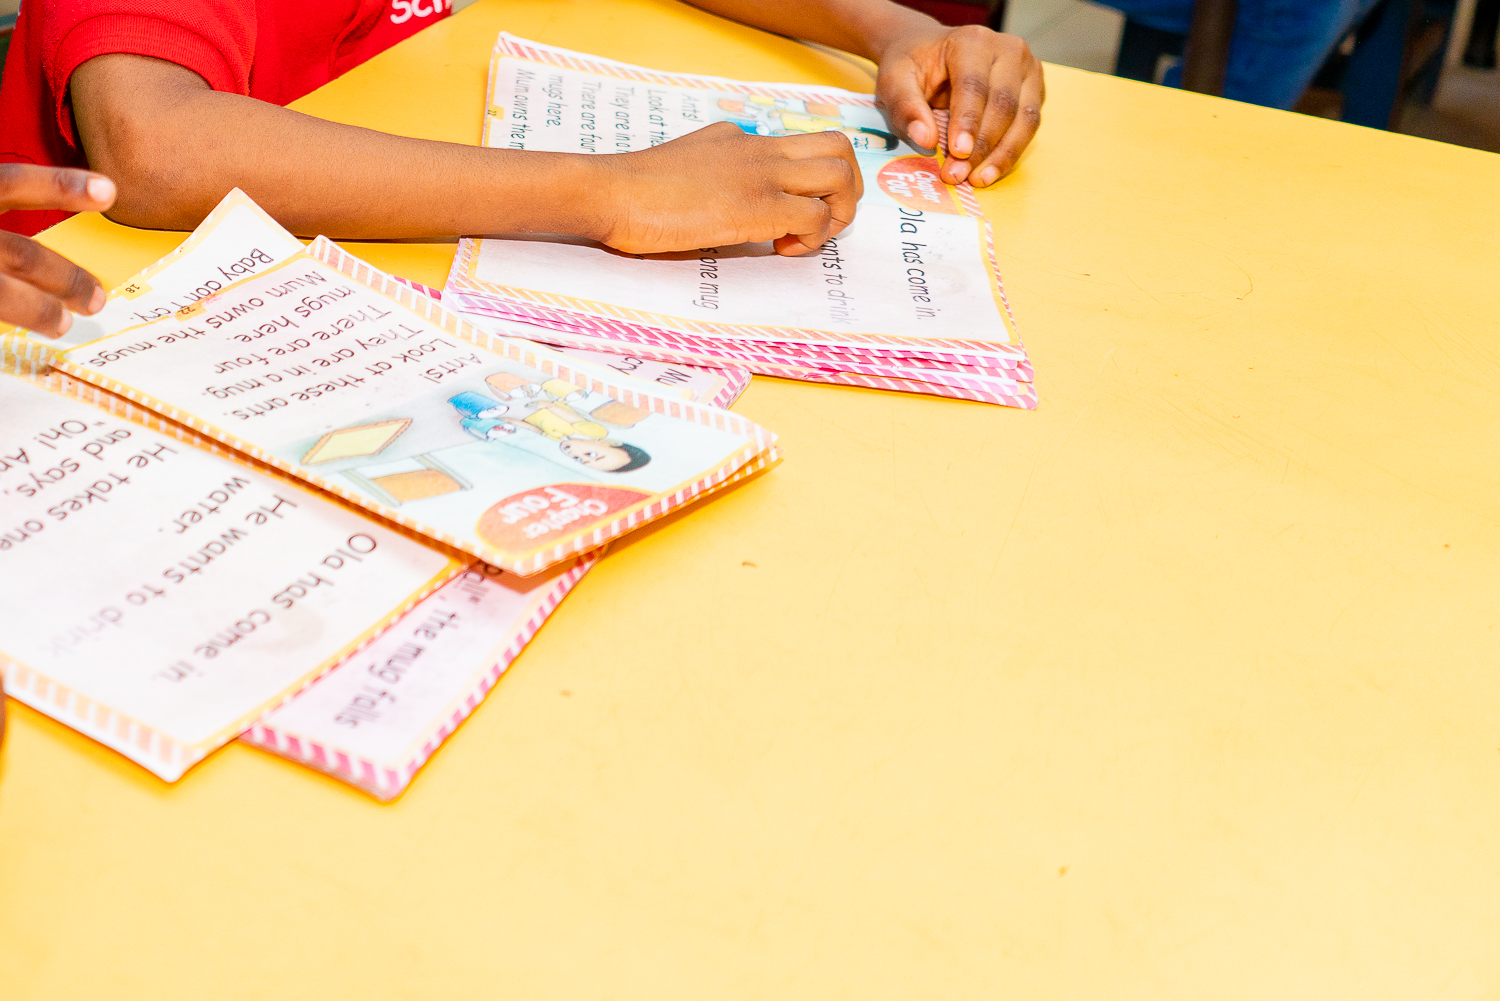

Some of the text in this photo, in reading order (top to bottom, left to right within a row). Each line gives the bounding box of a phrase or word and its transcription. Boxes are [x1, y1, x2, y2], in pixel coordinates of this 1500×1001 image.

[513, 68, 536, 98] Mum
[609, 86, 635, 110] They
[512, 94, 529, 122] owns
[542, 74, 568, 128] mugs here.
[579, 81, 603, 153] There are four
[647, 88, 670, 113] Look
[680, 92, 705, 122] Ants!
[510, 123, 533, 140] the
[614, 111, 631, 131] are
[649, 113, 668, 128] at
[614, 133, 636, 142] in
[882, 171, 916, 198] Four
[914, 170, 942, 204] Chapter
[217, 248, 274, 281] Baby
[699, 256, 719, 280] one
[901, 241, 928, 265] has
[125, 283, 141, 294] 18
[692, 281, 719, 310] mug
[820, 237, 859, 325] ants to drink
[906, 268, 931, 303] come
[80, 270, 328, 367] Mum owns the mugs.
[178, 305, 196, 316] 22
[225, 285, 357, 344] mugs here.
[915, 306, 941, 320] in.
[214, 305, 392, 375] There are four
[201, 323, 424, 400] They are in a mug.
[418, 353, 482, 384] Ants!
[222, 338, 457, 420] Look at these ants.
[81, 428, 132, 461] and
[127, 442, 179, 468] He
[47, 472, 131, 521] takes
[498, 486, 581, 525] Four
[521, 497, 609, 540] Chapter
[48, 494, 298, 658] He wants to drink
[151, 532, 378, 684] Ola has come in.
[413, 607, 462, 642] the
[368, 641, 426, 684] mug
[334, 684, 397, 729] falls
